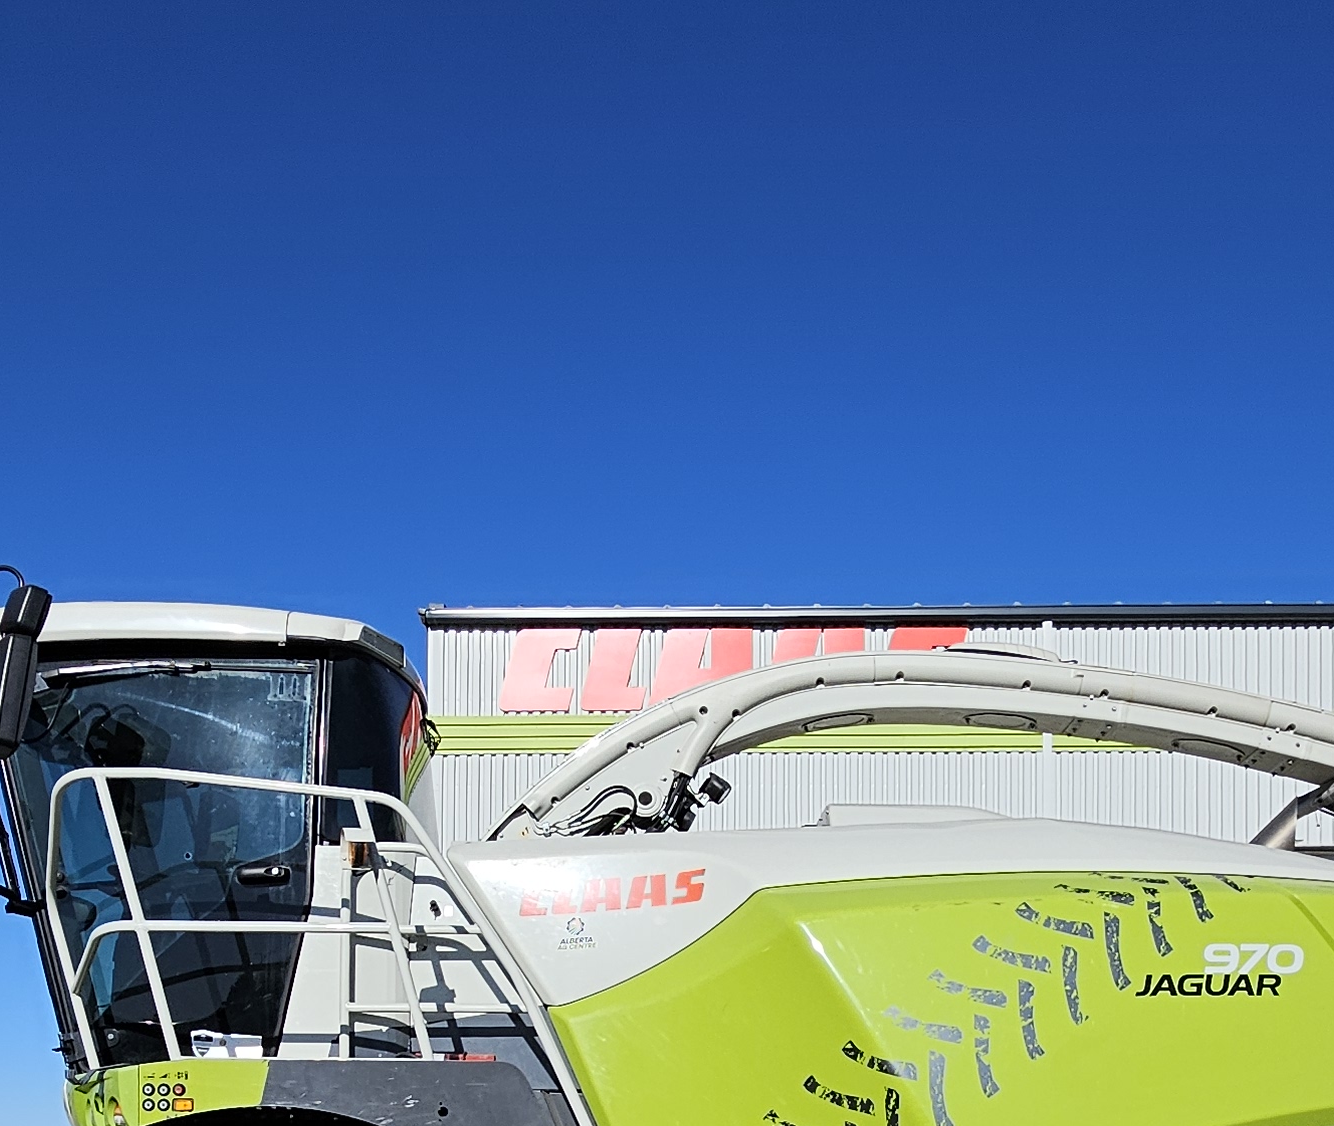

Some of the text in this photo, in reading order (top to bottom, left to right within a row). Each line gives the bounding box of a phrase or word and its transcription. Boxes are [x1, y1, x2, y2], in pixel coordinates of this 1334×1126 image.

[500, 627, 968, 712] CLA
[519, 868, 706, 917] CLAAS
[560, 936, 593, 944] ALBERTA
[569, 942, 596, 950] CENTRE
[1203, 943, 1305, 975] 970
[1135, 973, 1284, 998] JAGUAR
